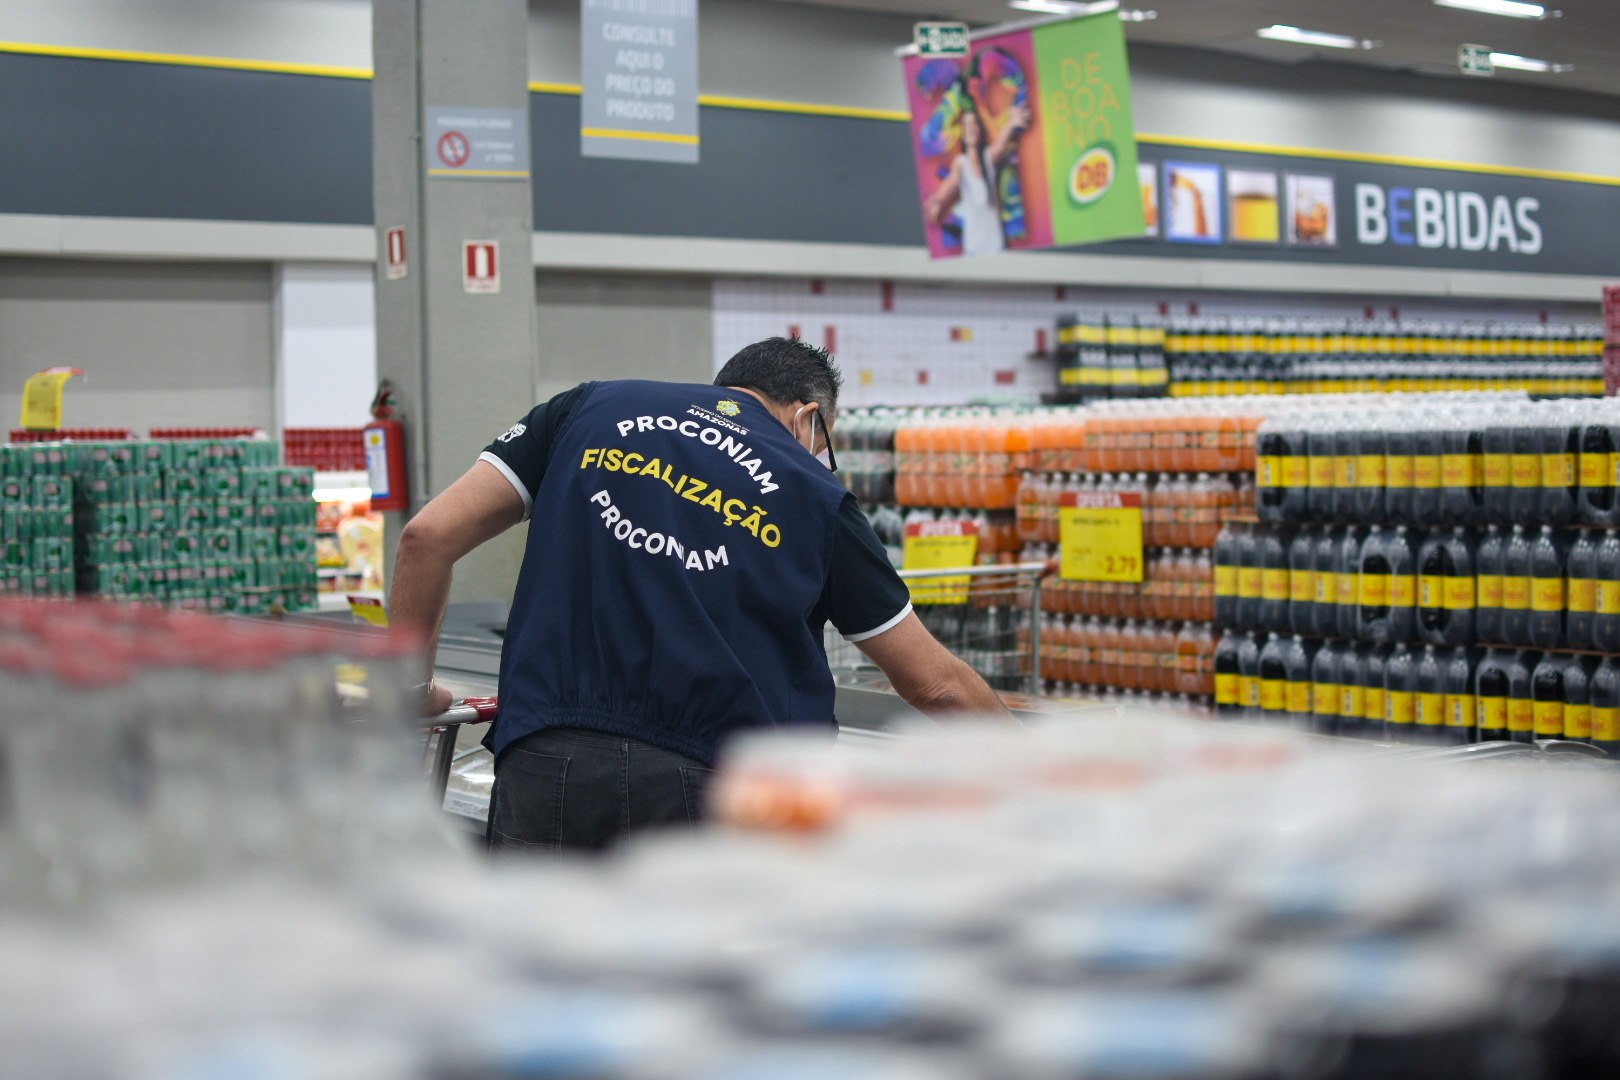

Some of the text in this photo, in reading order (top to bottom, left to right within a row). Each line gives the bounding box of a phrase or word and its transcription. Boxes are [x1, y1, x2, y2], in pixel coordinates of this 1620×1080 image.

[602, 22, 676, 47] CONSULTE
[615, 49, 665, 73] AQUI O
[1059, 51, 1101, 90] DE
[605, 73, 675, 99] PREÇO DO
[605, 98, 675, 122] PRODUTO
[1050, 82, 1121, 123] BOA
[1064, 113, 1113, 149] NO
[1355, 182, 1543, 255] BEBIDAS
[686, 408, 748, 436] AMAZONAS
[580, 447, 782, 548] FISCALIZAÇÃO
